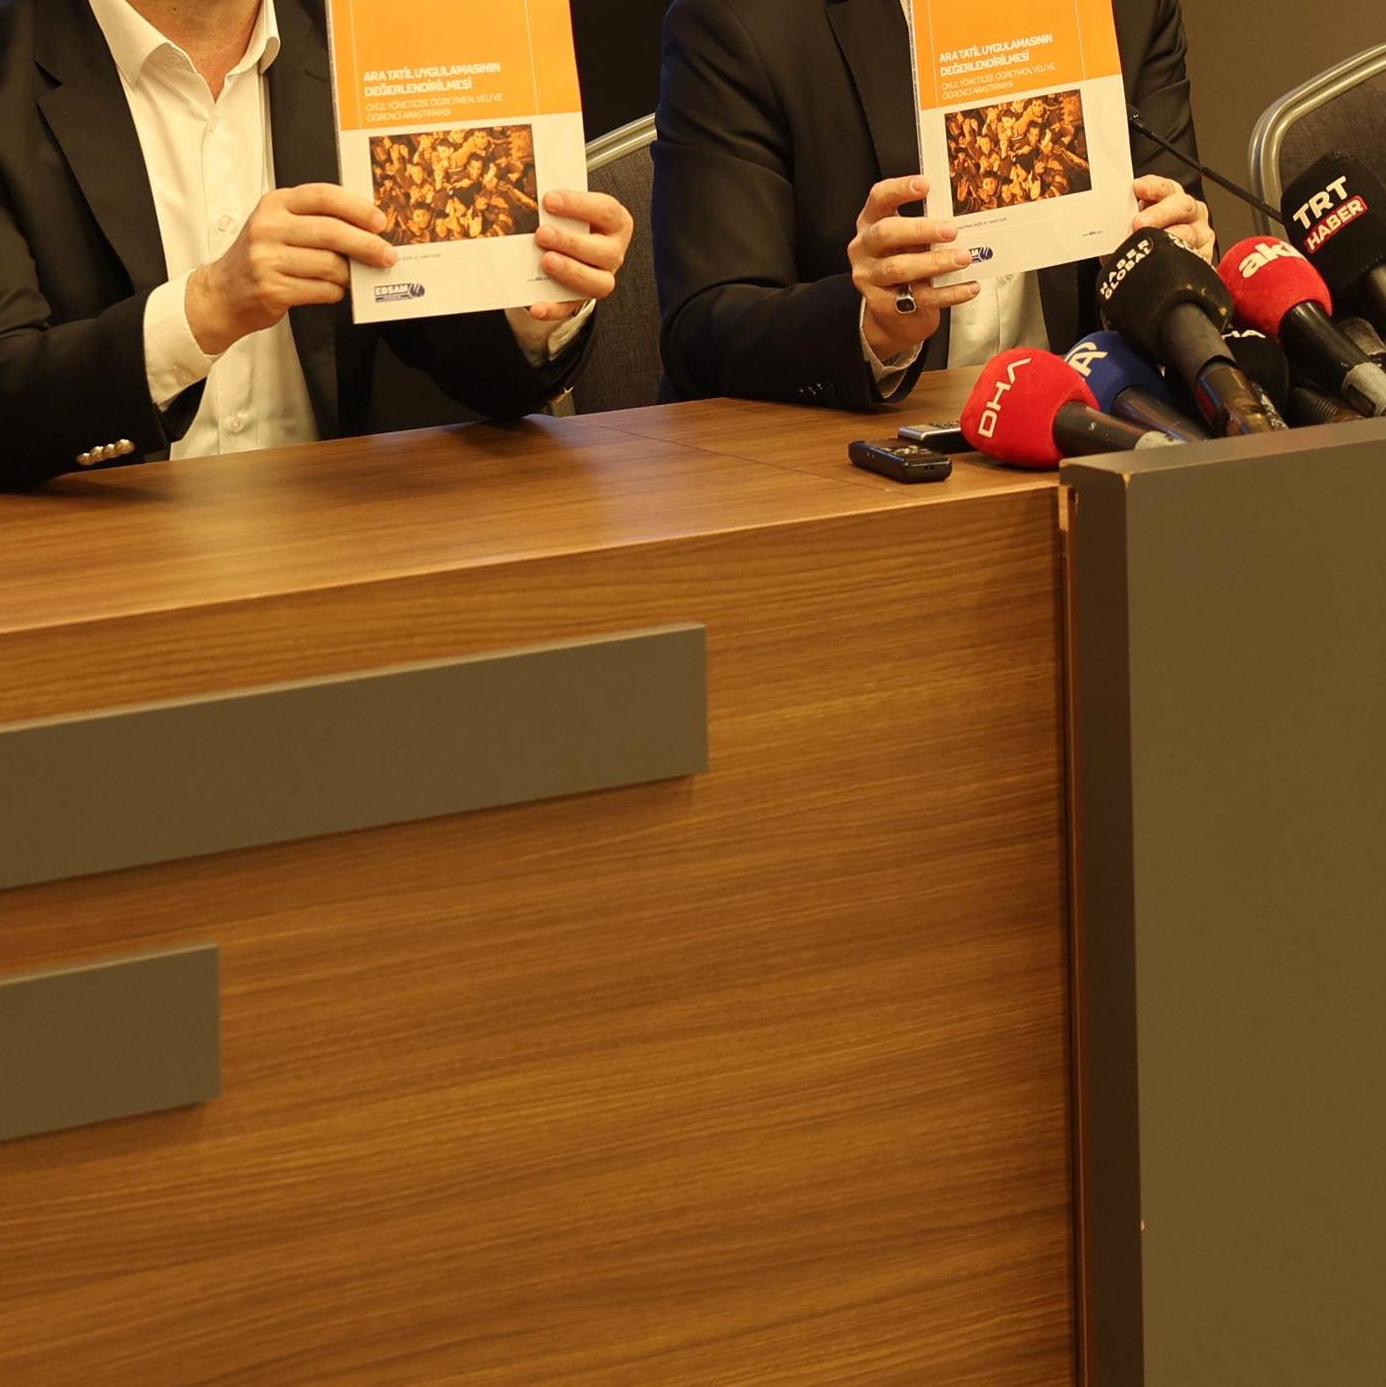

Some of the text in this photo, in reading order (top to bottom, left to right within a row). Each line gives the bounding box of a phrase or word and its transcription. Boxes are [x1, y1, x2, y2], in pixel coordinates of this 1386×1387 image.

[364, 71, 388, 82] ARA
[940, 53, 958, 63] ARA
[1292, 175, 1348, 230] TRT
[1307, 198, 1364, 250] HABER
[978, 357, 1032, 438] DHA
